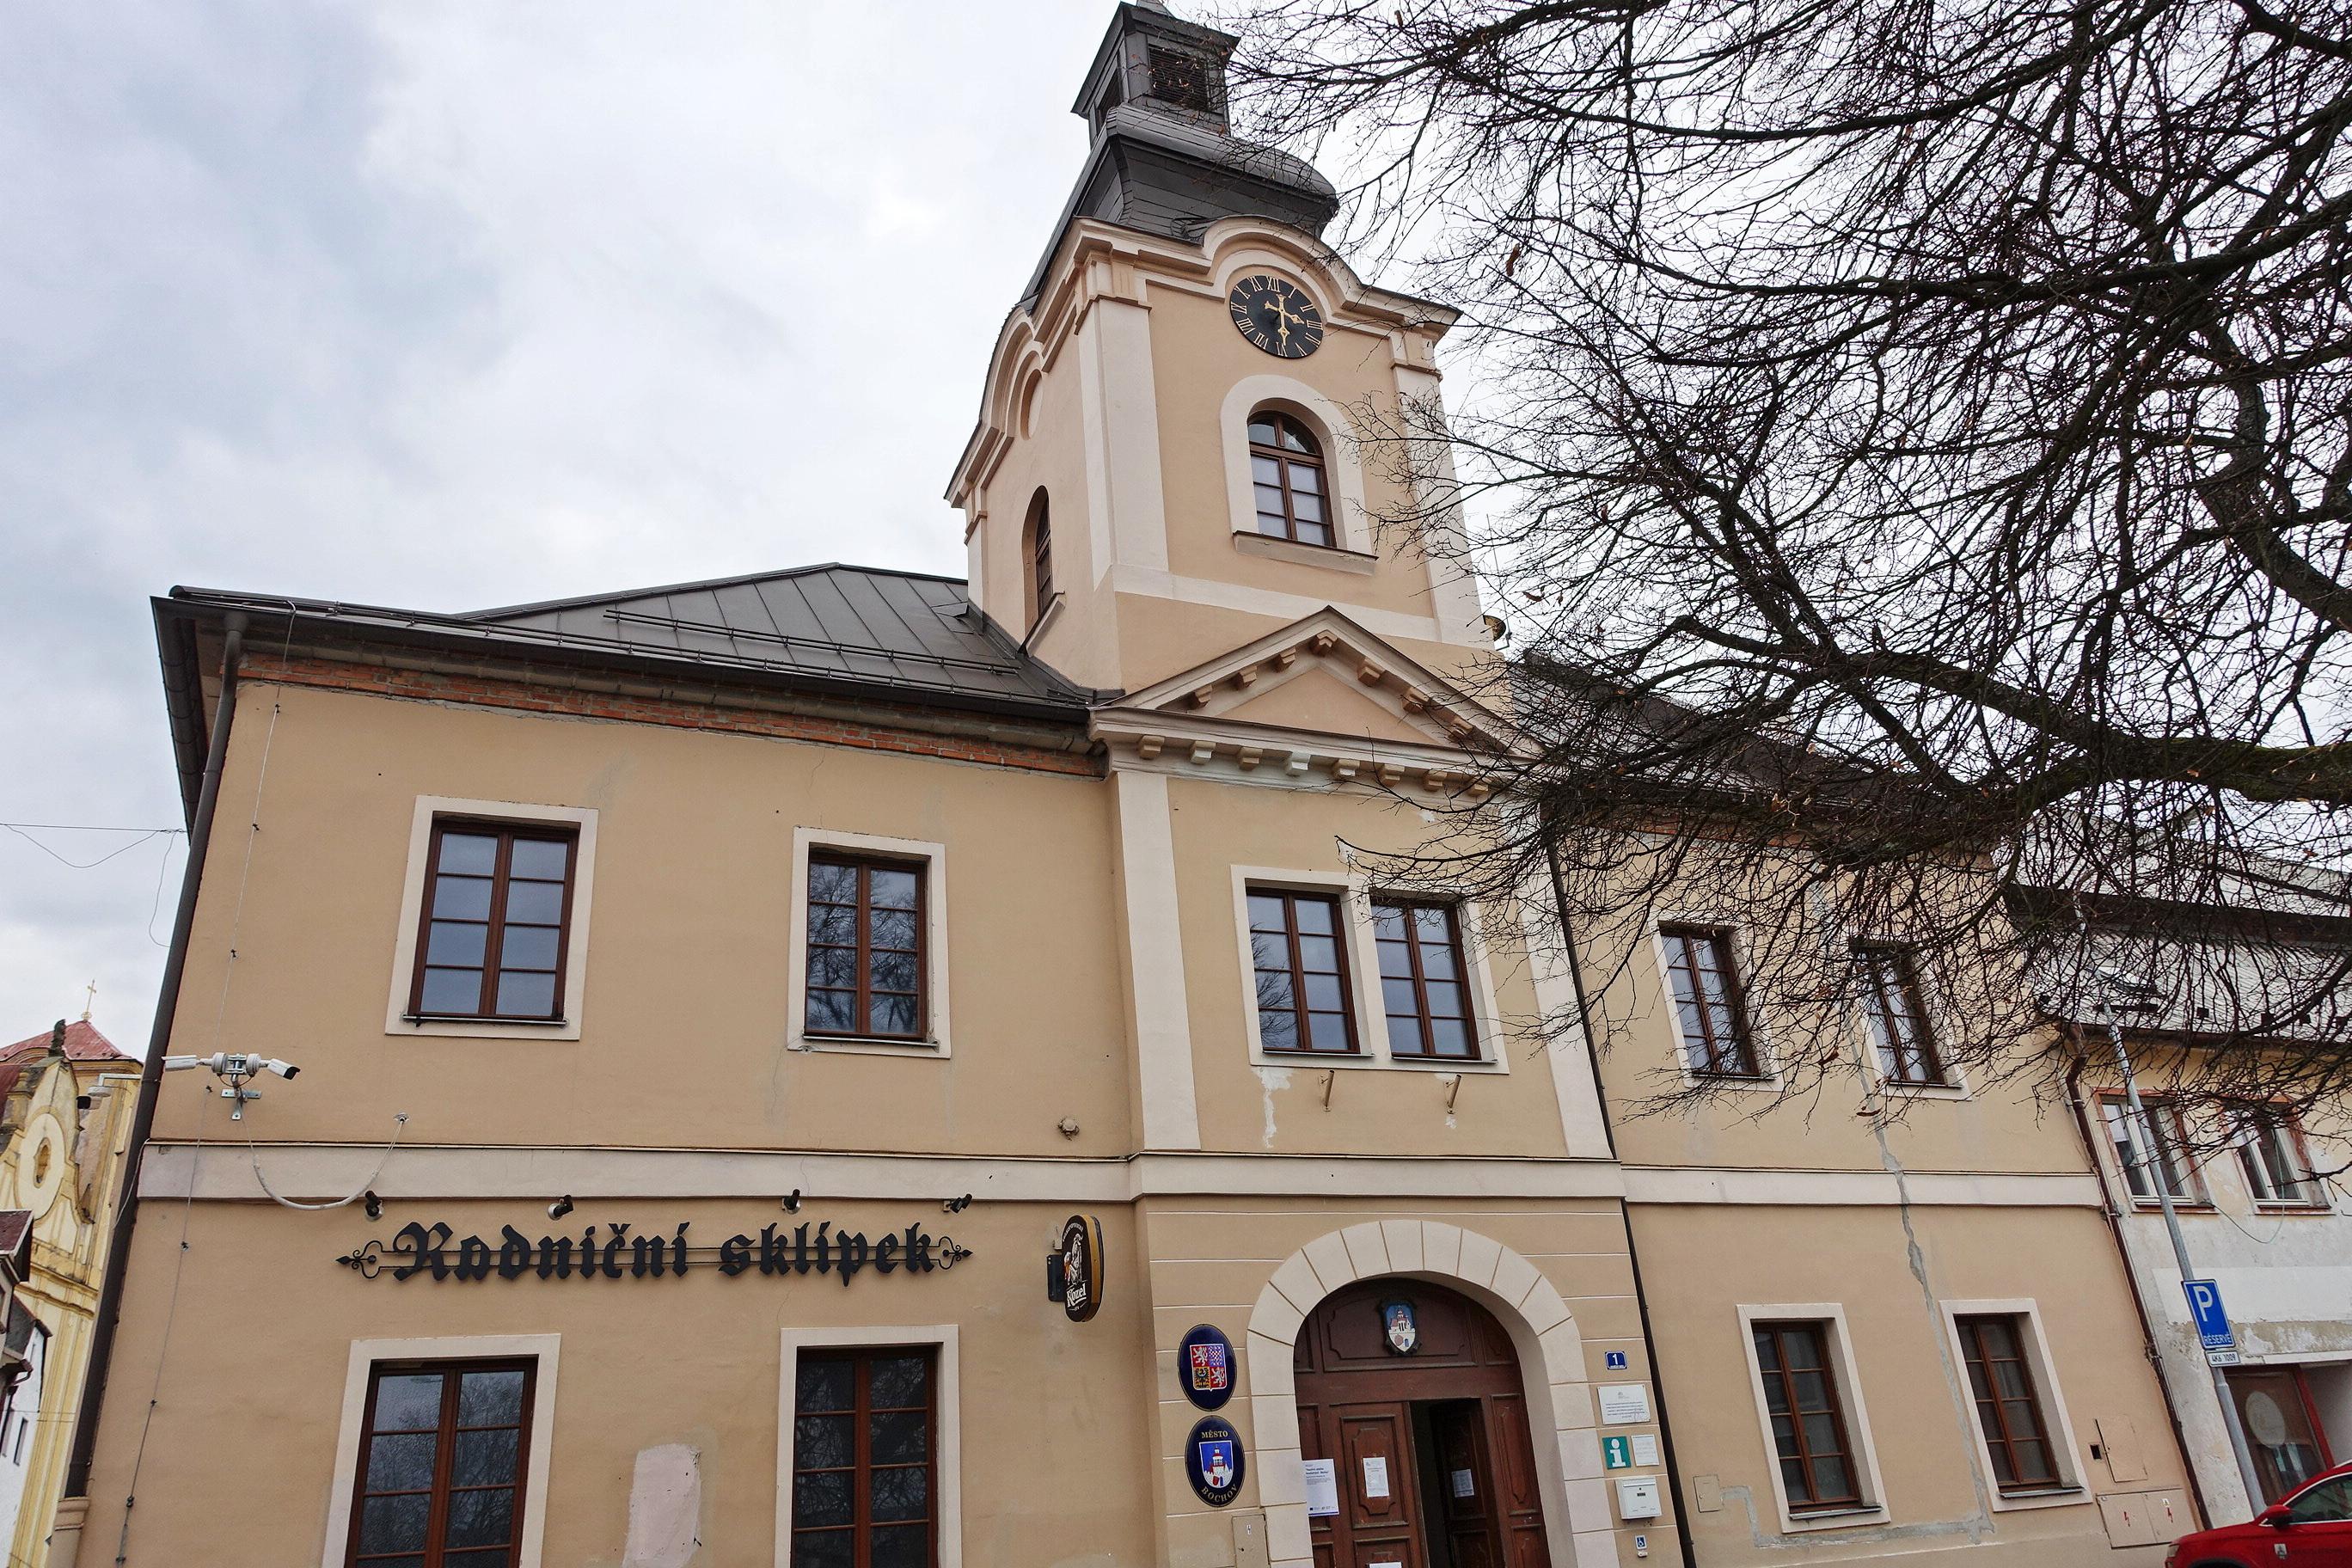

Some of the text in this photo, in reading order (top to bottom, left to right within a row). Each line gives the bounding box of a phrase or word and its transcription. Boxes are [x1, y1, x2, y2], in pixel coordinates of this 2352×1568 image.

[393, 1221, 935, 1288] Radniční sklípek
[1066, 1283, 1087, 1308] Kozel
[2193, 1285, 2213, 1322] P
[1612, 1353, 1619, 1365] 1
[1201, 1430, 1228, 1439] MĚSTO
[1201, 1483, 1238, 1503] BOCHOV
